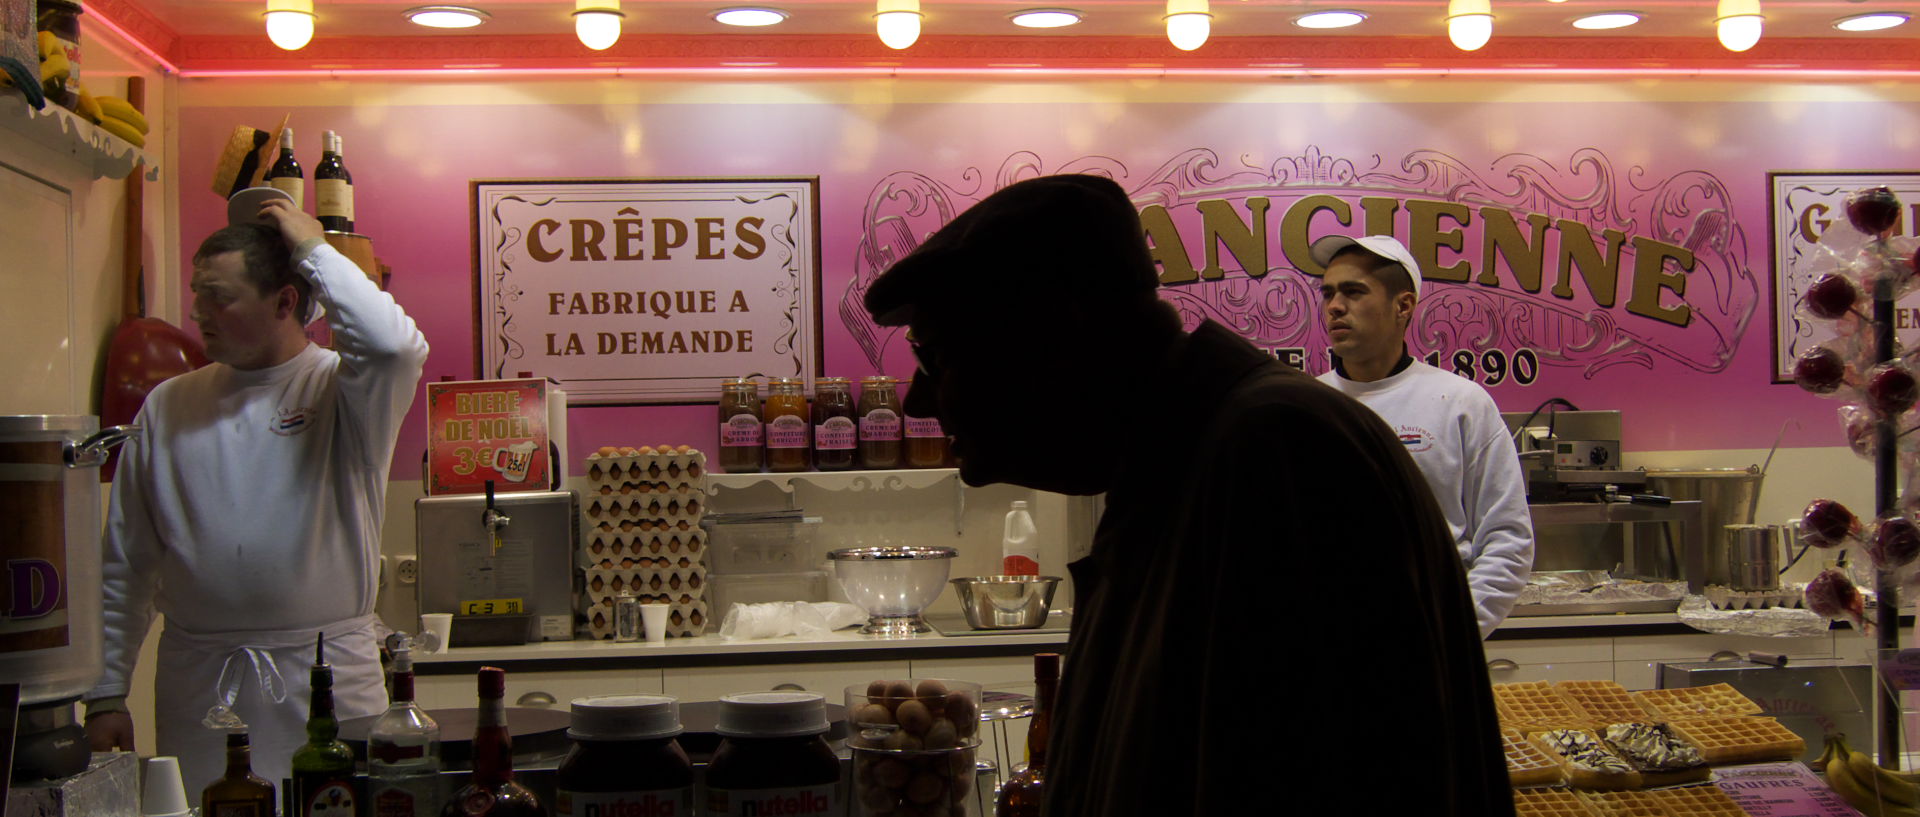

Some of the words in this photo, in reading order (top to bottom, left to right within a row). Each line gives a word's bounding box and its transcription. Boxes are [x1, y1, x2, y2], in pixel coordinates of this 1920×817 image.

[526, 206, 767, 263] CRÊPES
[548, 290, 716, 320] FABRIQUE
[728, 290, 750, 313] A
[545, 332, 585, 357] LA
[597, 330, 753, 355] DEMANDE
[456, 390, 520, 415] BIERE
[444, 419, 474, 442] DE
[478, 414, 532, 441] NOËL
[452, 447, 493, 476] 3€
[1720, 780, 1804, 790] GAUFRES
[584, 794, 674, 817] nutella
[742, 790, 827, 817] nutella
